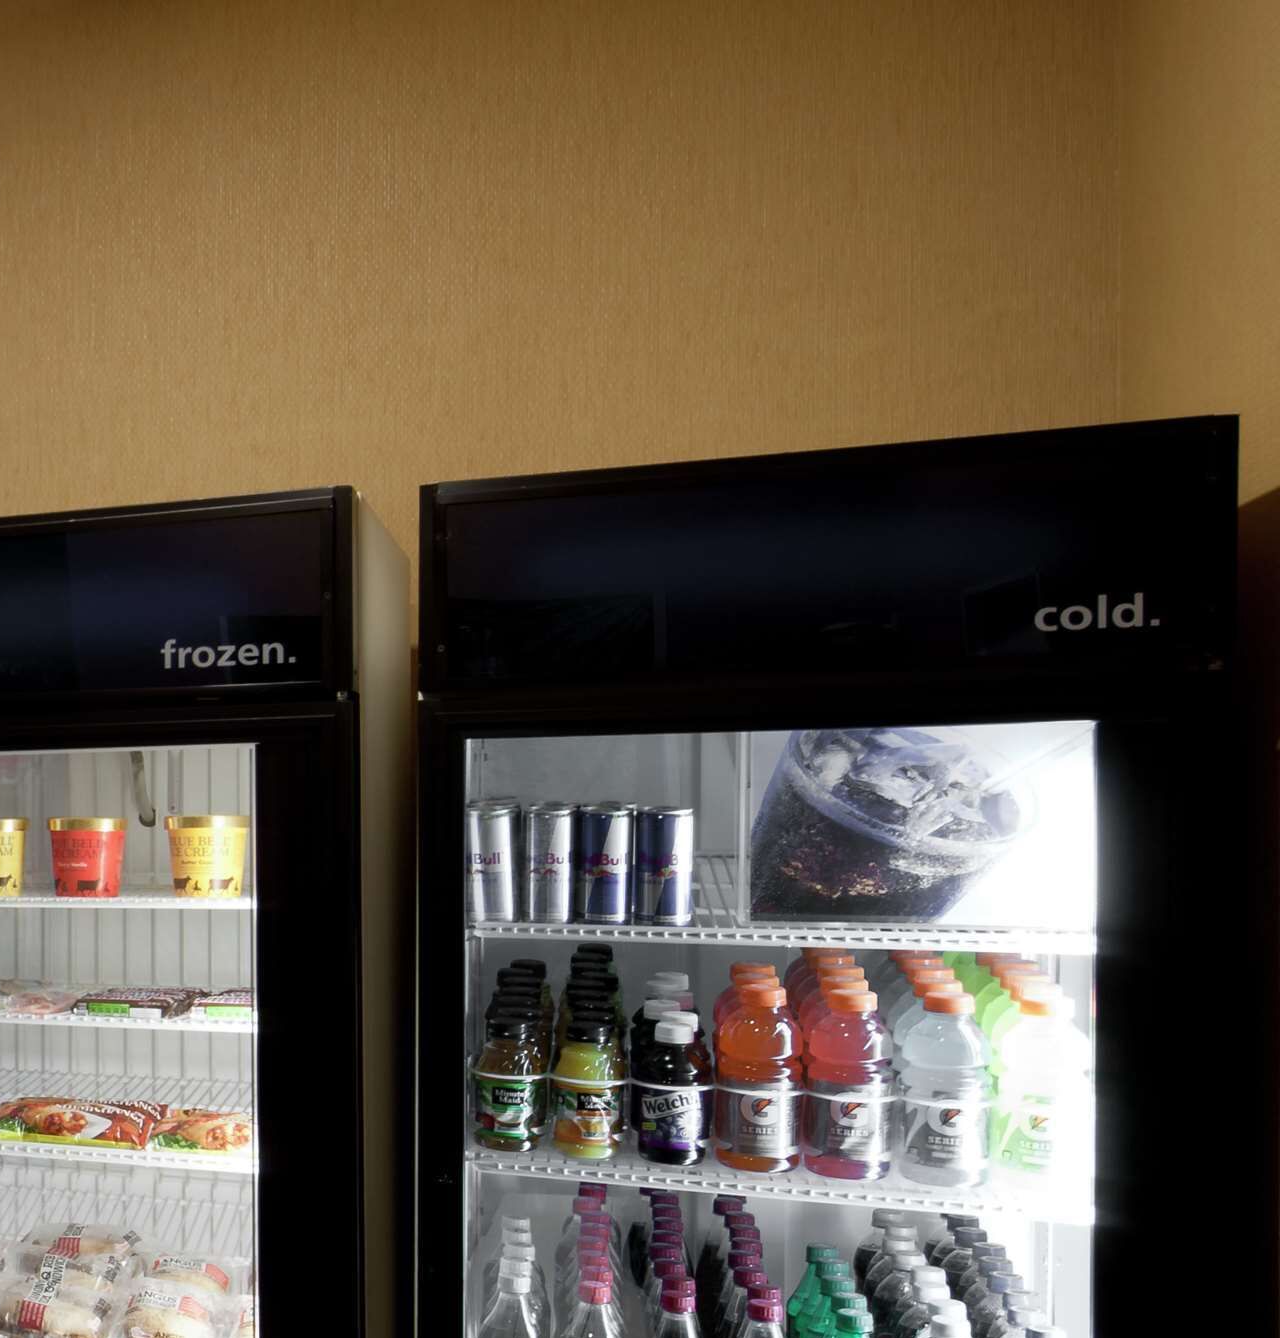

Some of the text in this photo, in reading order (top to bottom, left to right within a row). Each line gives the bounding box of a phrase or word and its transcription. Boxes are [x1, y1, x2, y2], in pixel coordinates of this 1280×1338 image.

[1034, 592, 1160, 632] cold.
[160, 639, 296, 669] frozen.
[474, 851, 501, 865] Bull
[644, 1094, 695, 1115] Welch
